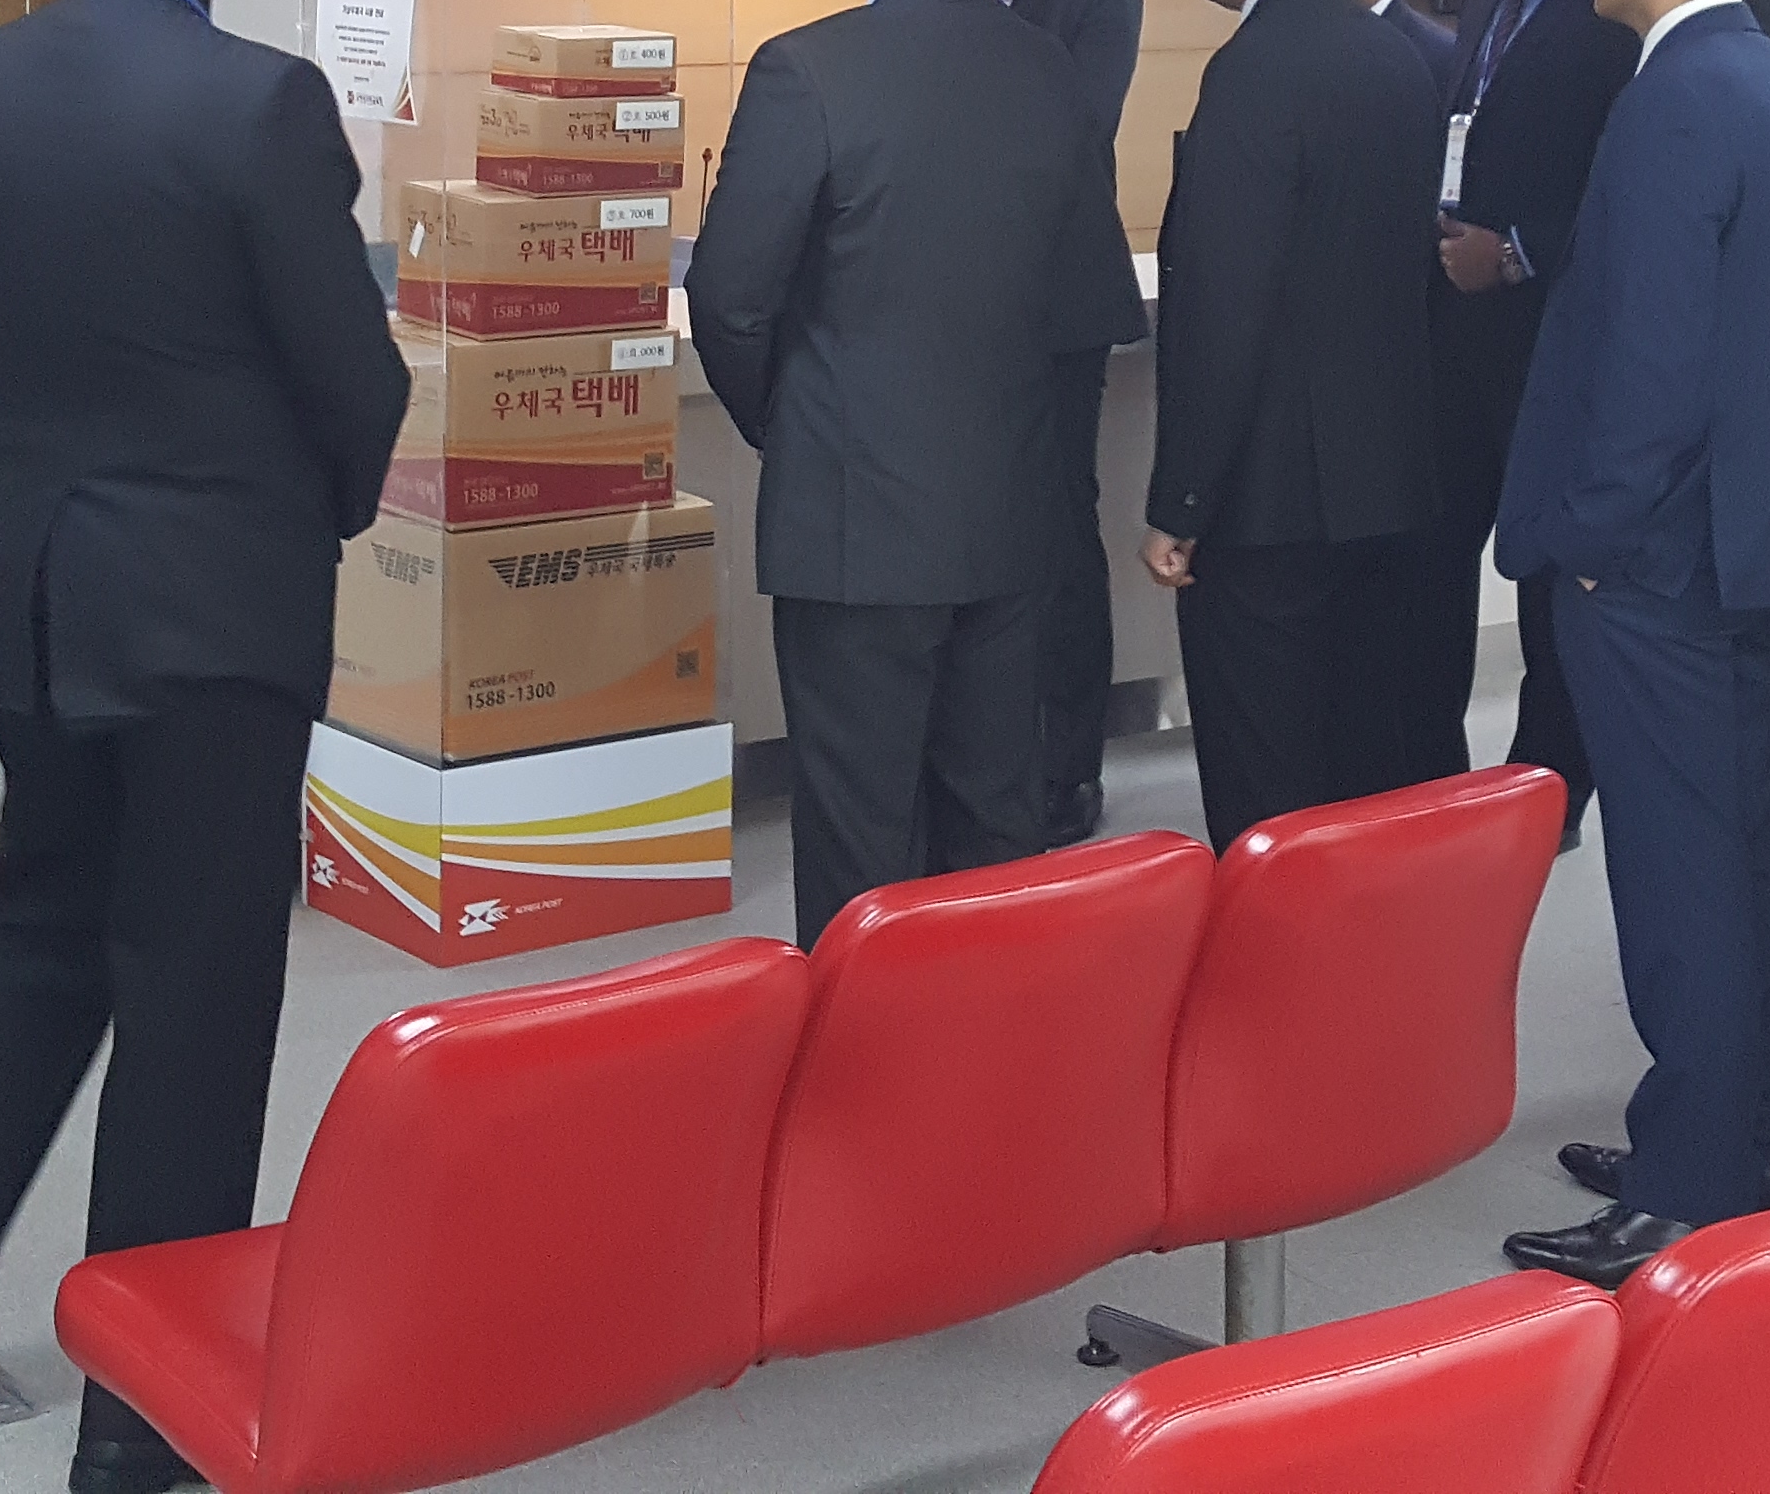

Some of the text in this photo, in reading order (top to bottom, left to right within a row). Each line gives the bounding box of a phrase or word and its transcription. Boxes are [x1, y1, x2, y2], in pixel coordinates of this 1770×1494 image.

[567, 123, 609, 141] 우체국
[518, 228, 635, 263] 우체국 택배
[492, 301, 560, 319] 1588-1300
[491, 373, 640, 421] 우체국 택배
[463, 483, 539, 504] 1588-1300
[515, 548, 583, 588] EMS
[469, 672, 506, 689] KOREA
[466, 681, 556, 710] 1588-1300
